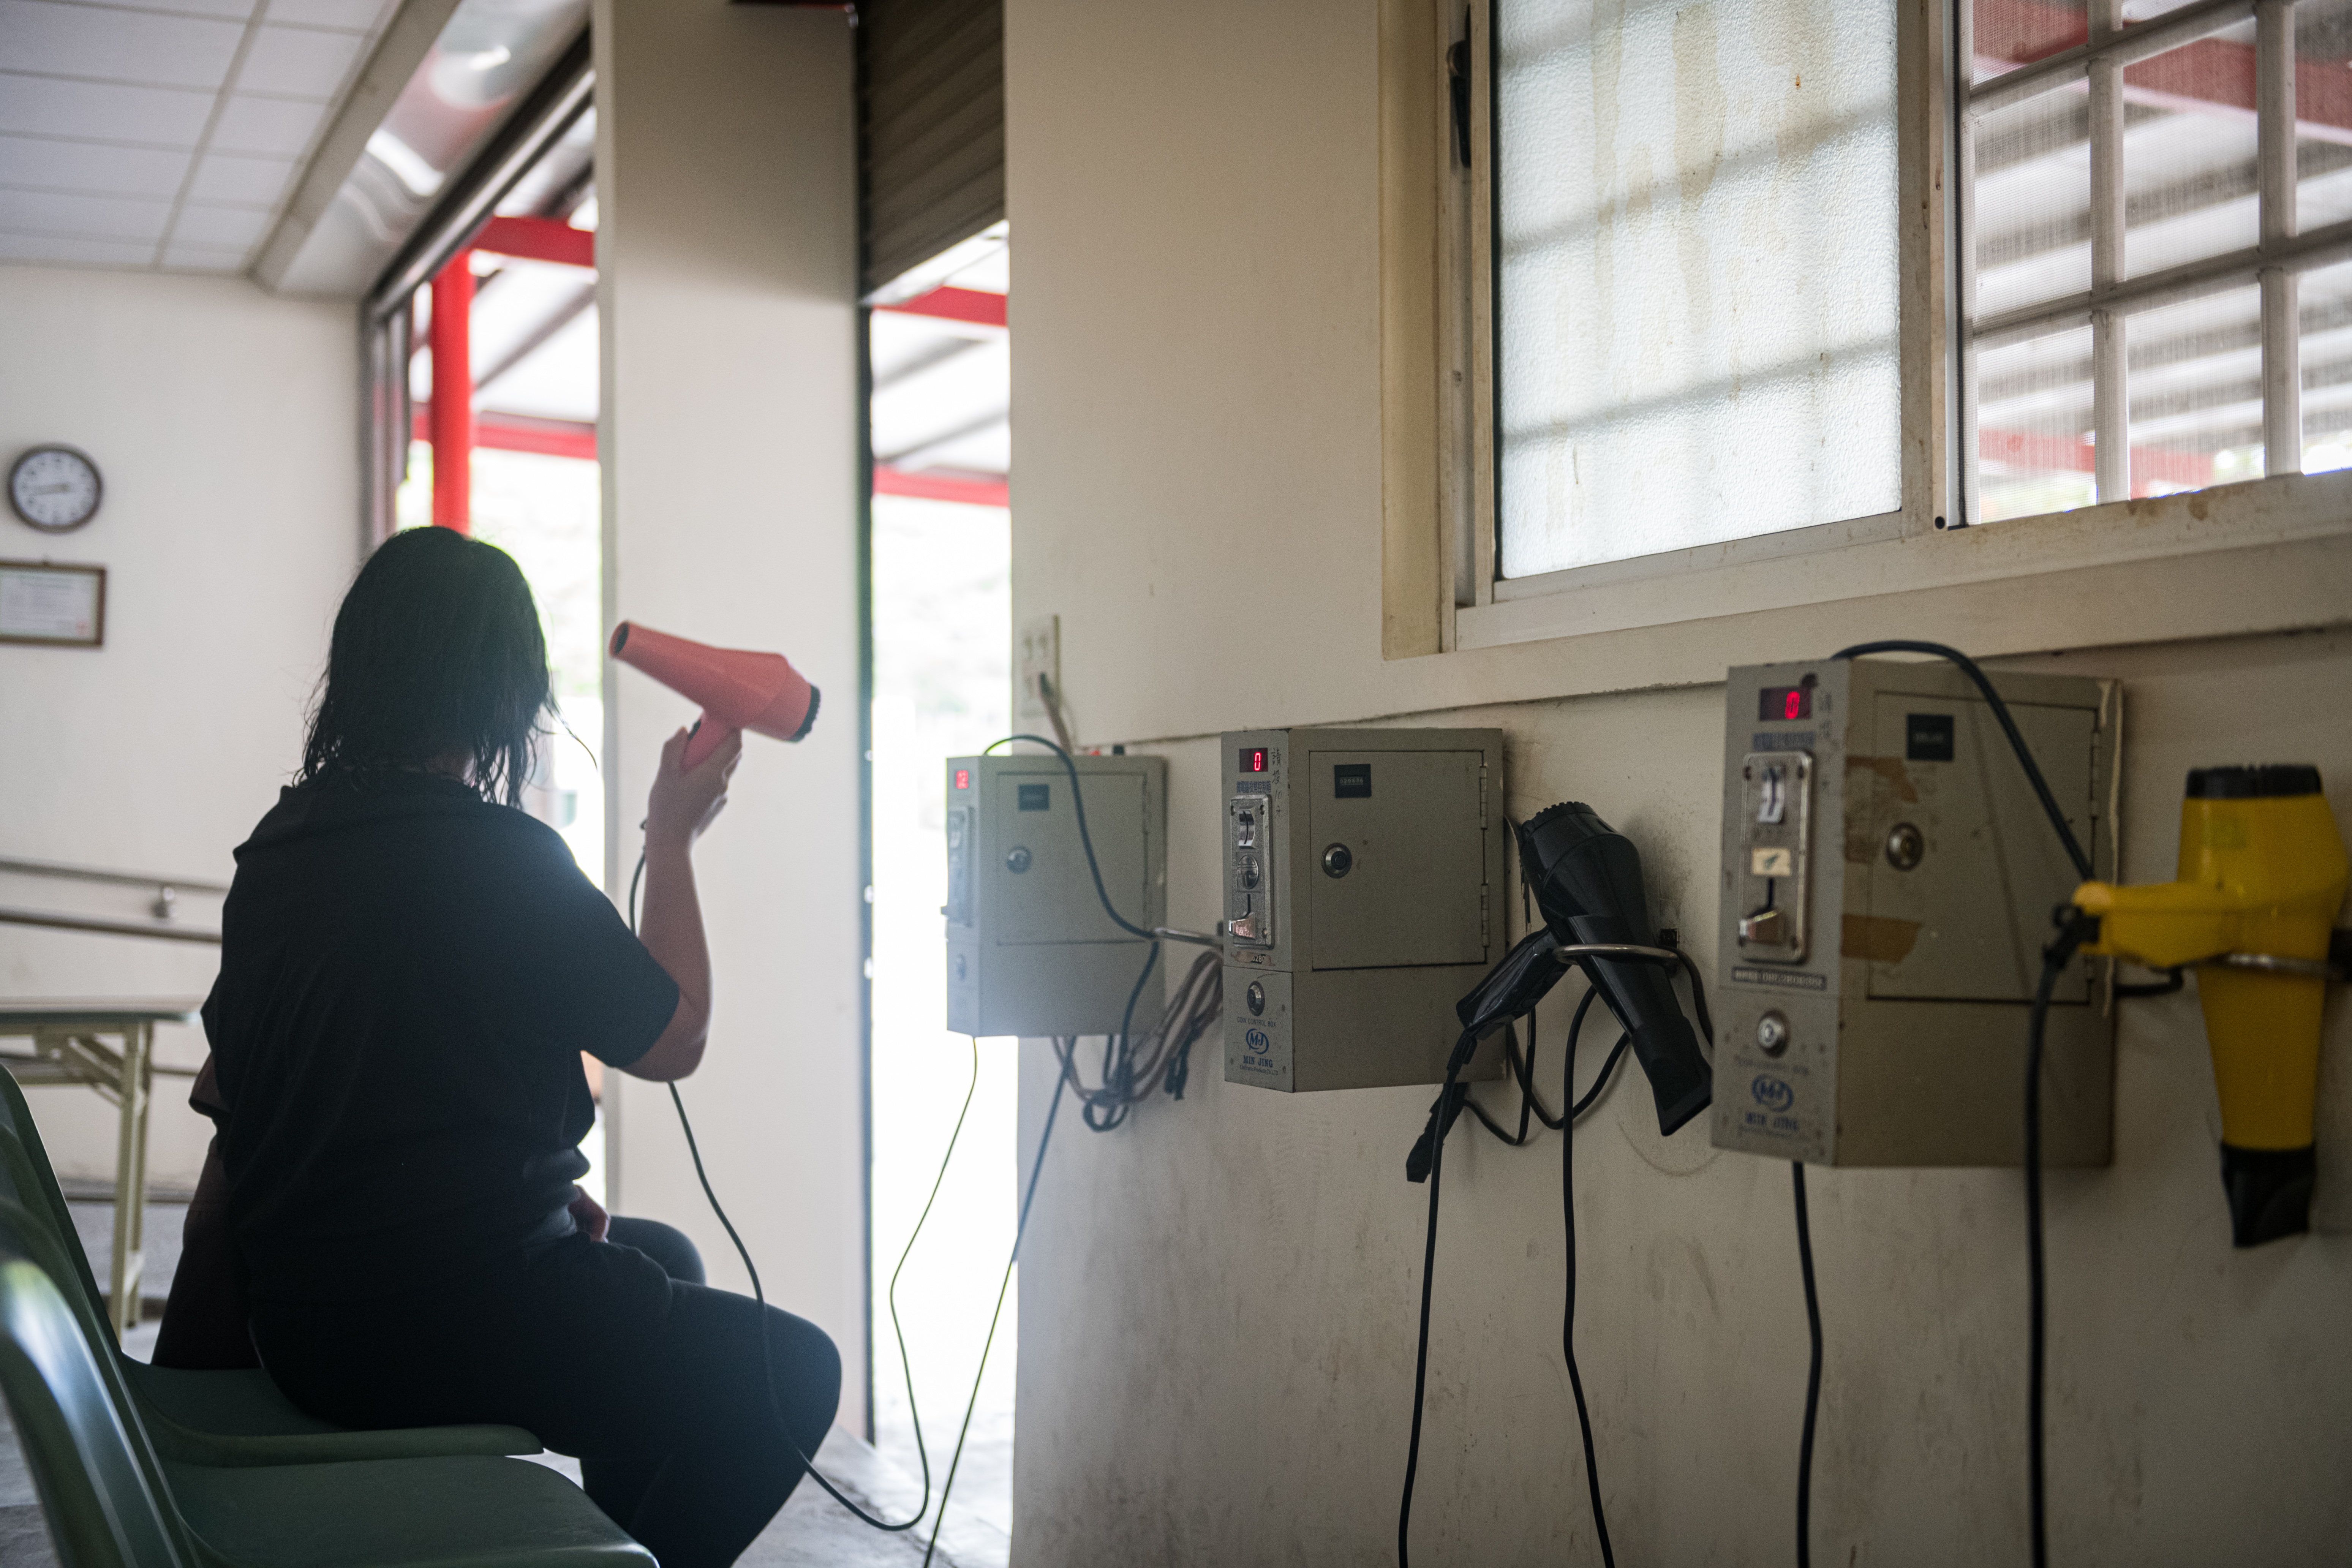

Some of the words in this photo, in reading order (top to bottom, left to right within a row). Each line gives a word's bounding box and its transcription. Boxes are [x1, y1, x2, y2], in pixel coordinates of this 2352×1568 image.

[1785, 691, 1800, 719] 0
[1254, 752, 1261, 771] 0
[1248, 1018, 1266, 1026] CONTROL
[1243, 1055, 1255, 1065] MIN
[1258, 1058, 1273, 1068] JING
